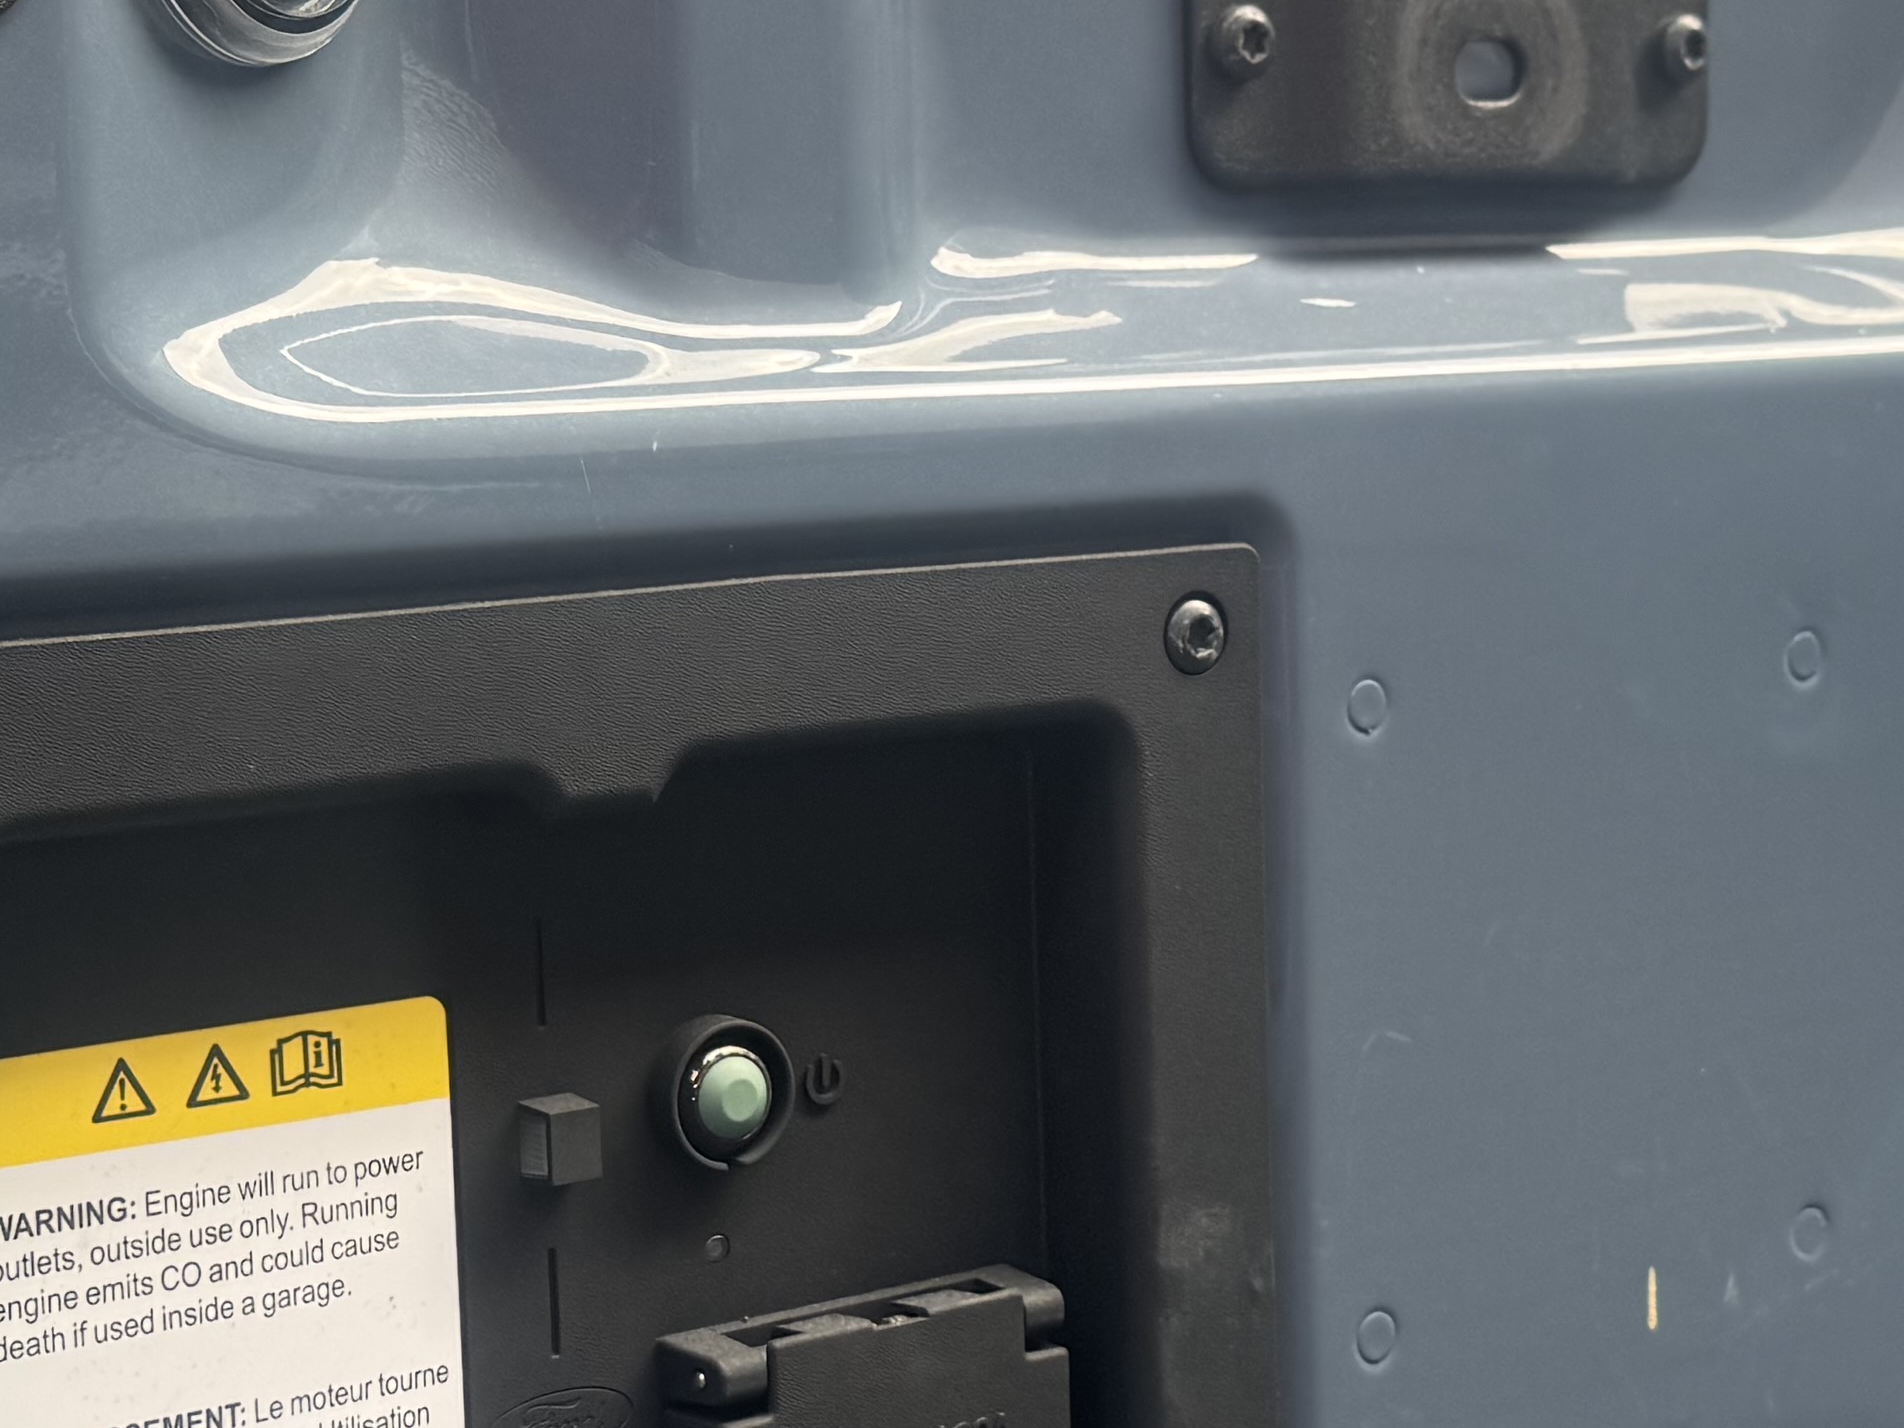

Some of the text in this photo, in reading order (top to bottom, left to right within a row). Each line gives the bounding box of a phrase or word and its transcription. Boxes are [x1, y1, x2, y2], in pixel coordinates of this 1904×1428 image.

[144, 1181, 233, 1219] Engine
[236, 1168, 276, 1203] will
[281, 1168, 321, 1195] run
[325, 1160, 349, 1187] to
[352, 1149, 425, 1190] power
[88, 1226, 183, 1267] outside
[188, 1221, 235, 1250] use
[238, 1206, 295, 1242] only.
[300, 1190, 399, 1230] Running
[84, 1271, 155, 1307] emits
[159, 1260, 203, 1293] CO
[207, 1249, 255, 1285] and
[259, 1236, 326, 1275] could
[329, 1229, 401, 1262] cause
[71, 1318, 90, 1350] if
[92, 1306, 156, 1346] used
[160, 1294, 236, 1333] inside
[240, 1294, 257, 1317] a
[260, 1277, 353, 1320] garage.
[253, 1396, 285, 1425] Le
[289, 1378, 374, 1418] moteur
[377, 1363, 450, 1398] tourne
